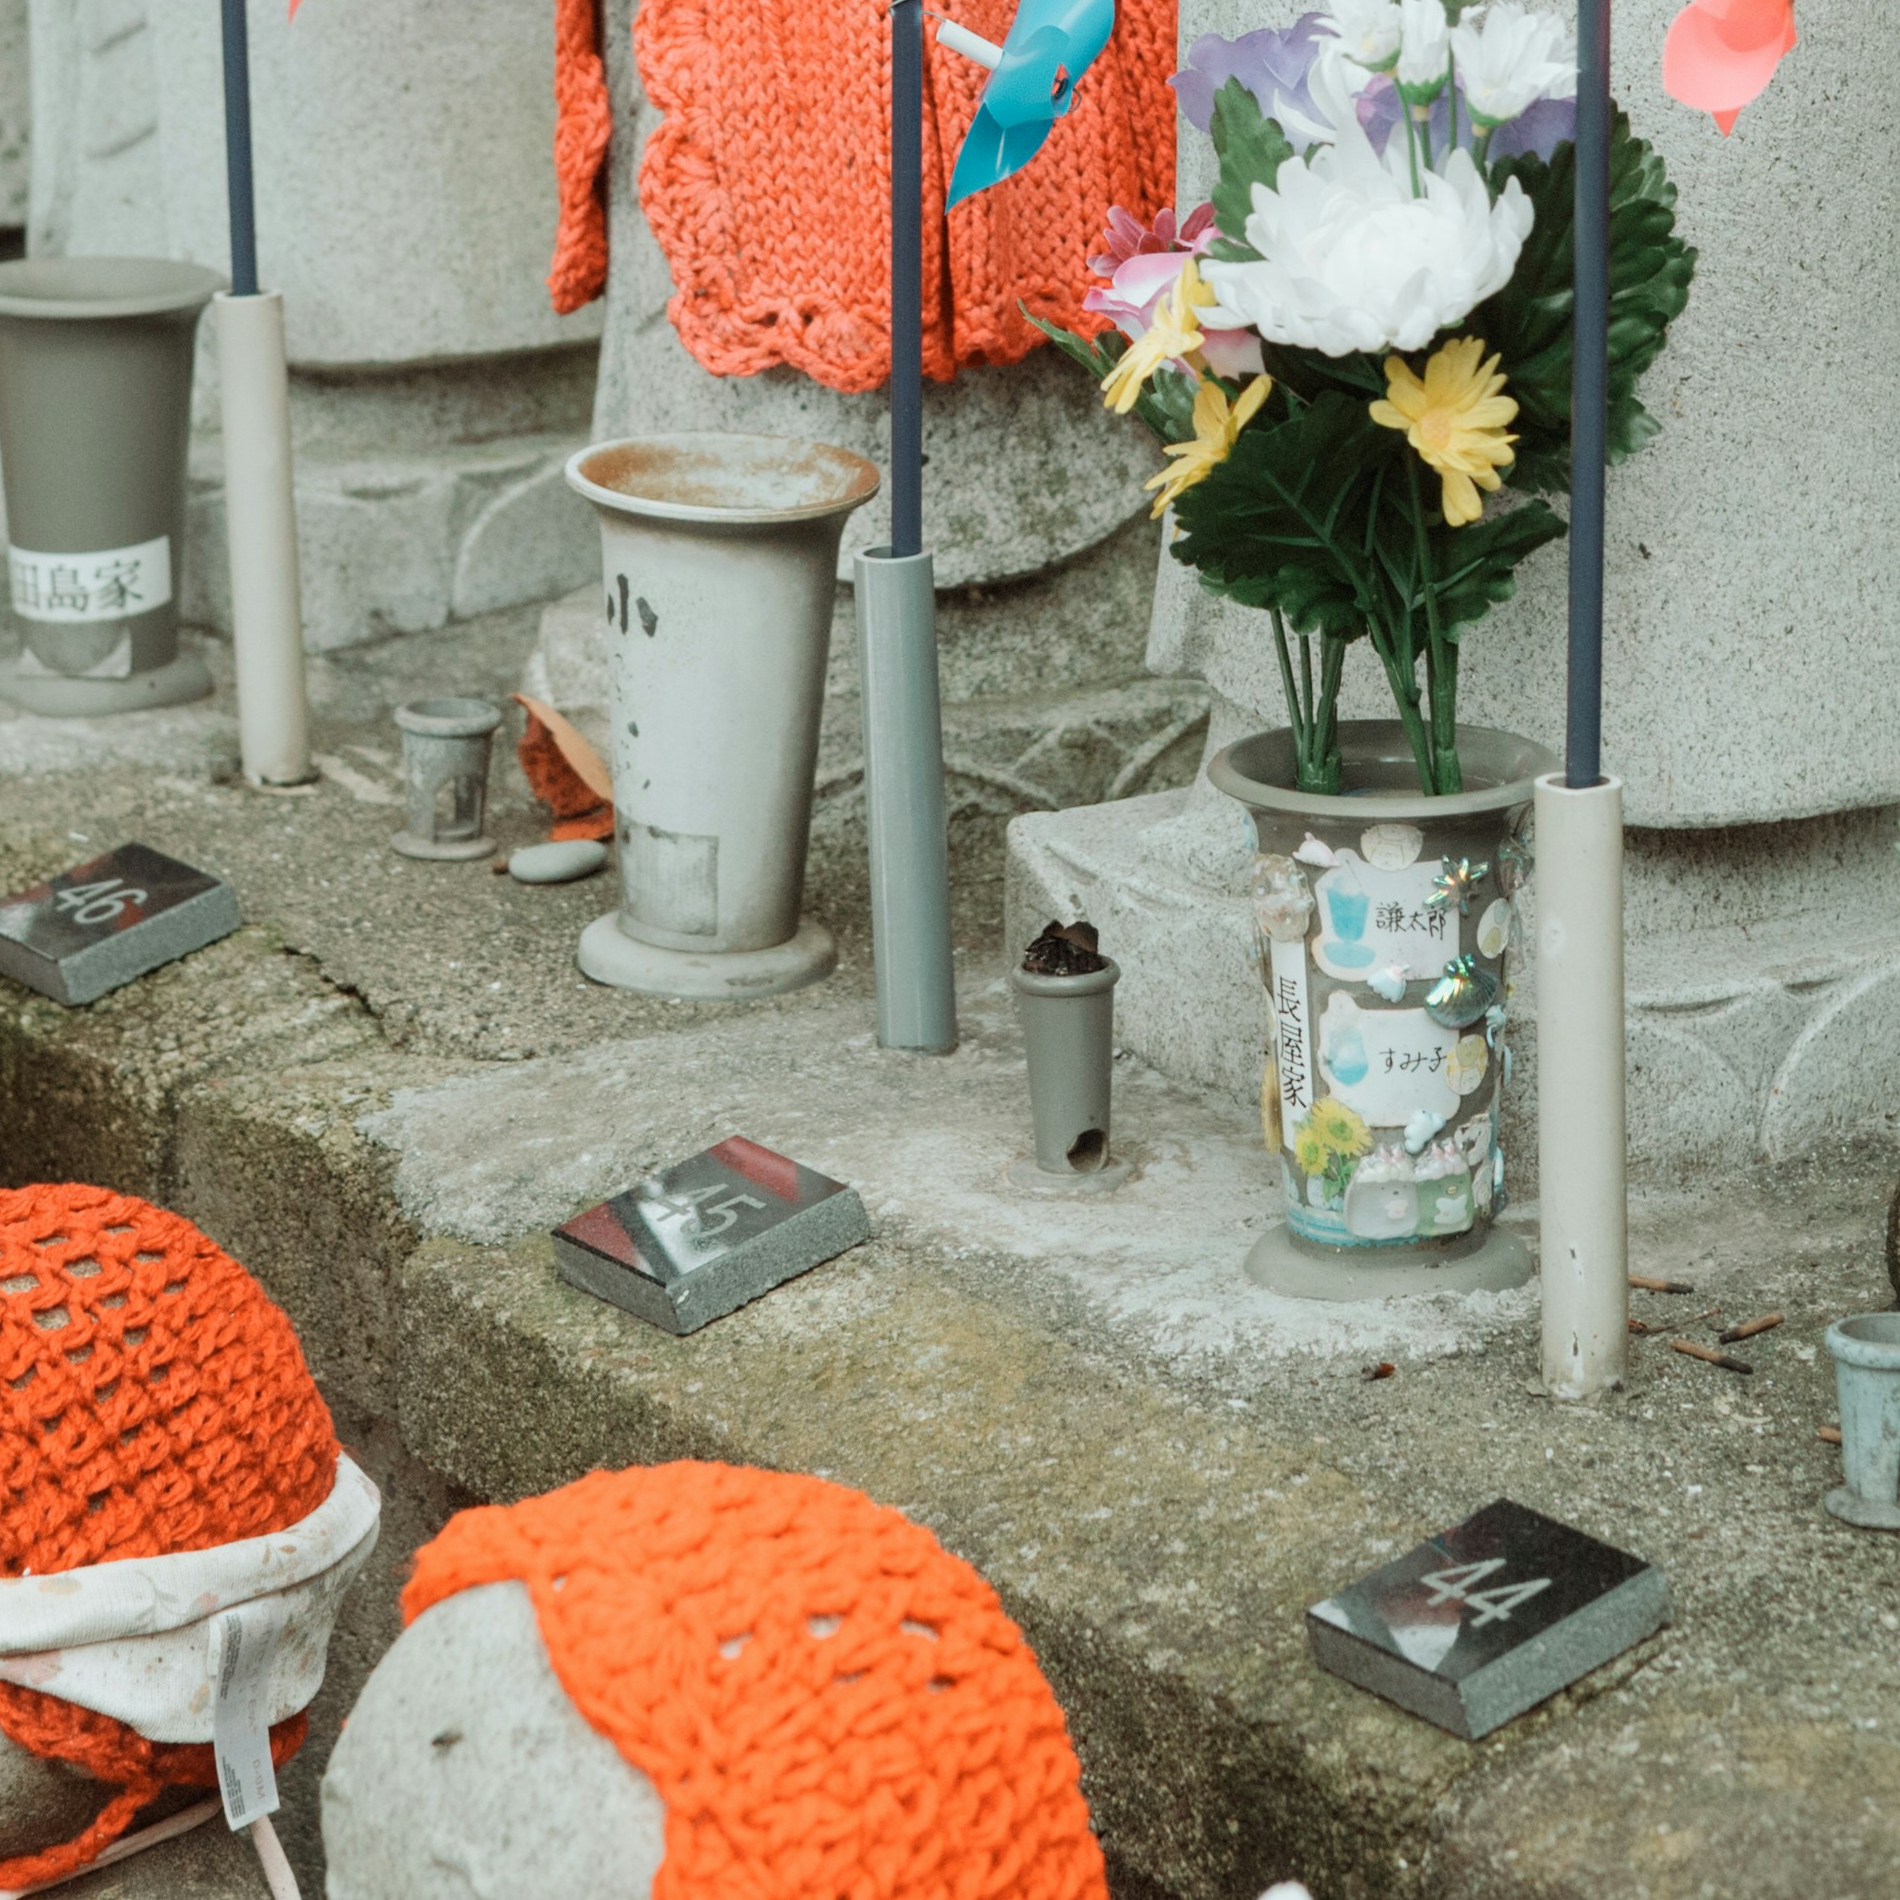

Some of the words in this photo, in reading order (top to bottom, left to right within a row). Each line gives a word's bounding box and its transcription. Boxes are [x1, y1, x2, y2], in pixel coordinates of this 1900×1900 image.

[55, 877, 149, 925] 46
[1276, 975, 1307, 1109] 長屋家
[1378, 1046, 1448, 1074] すみ子
[656, 1183, 768, 1238] 45
[1419, 1557, 1553, 1628] 44
